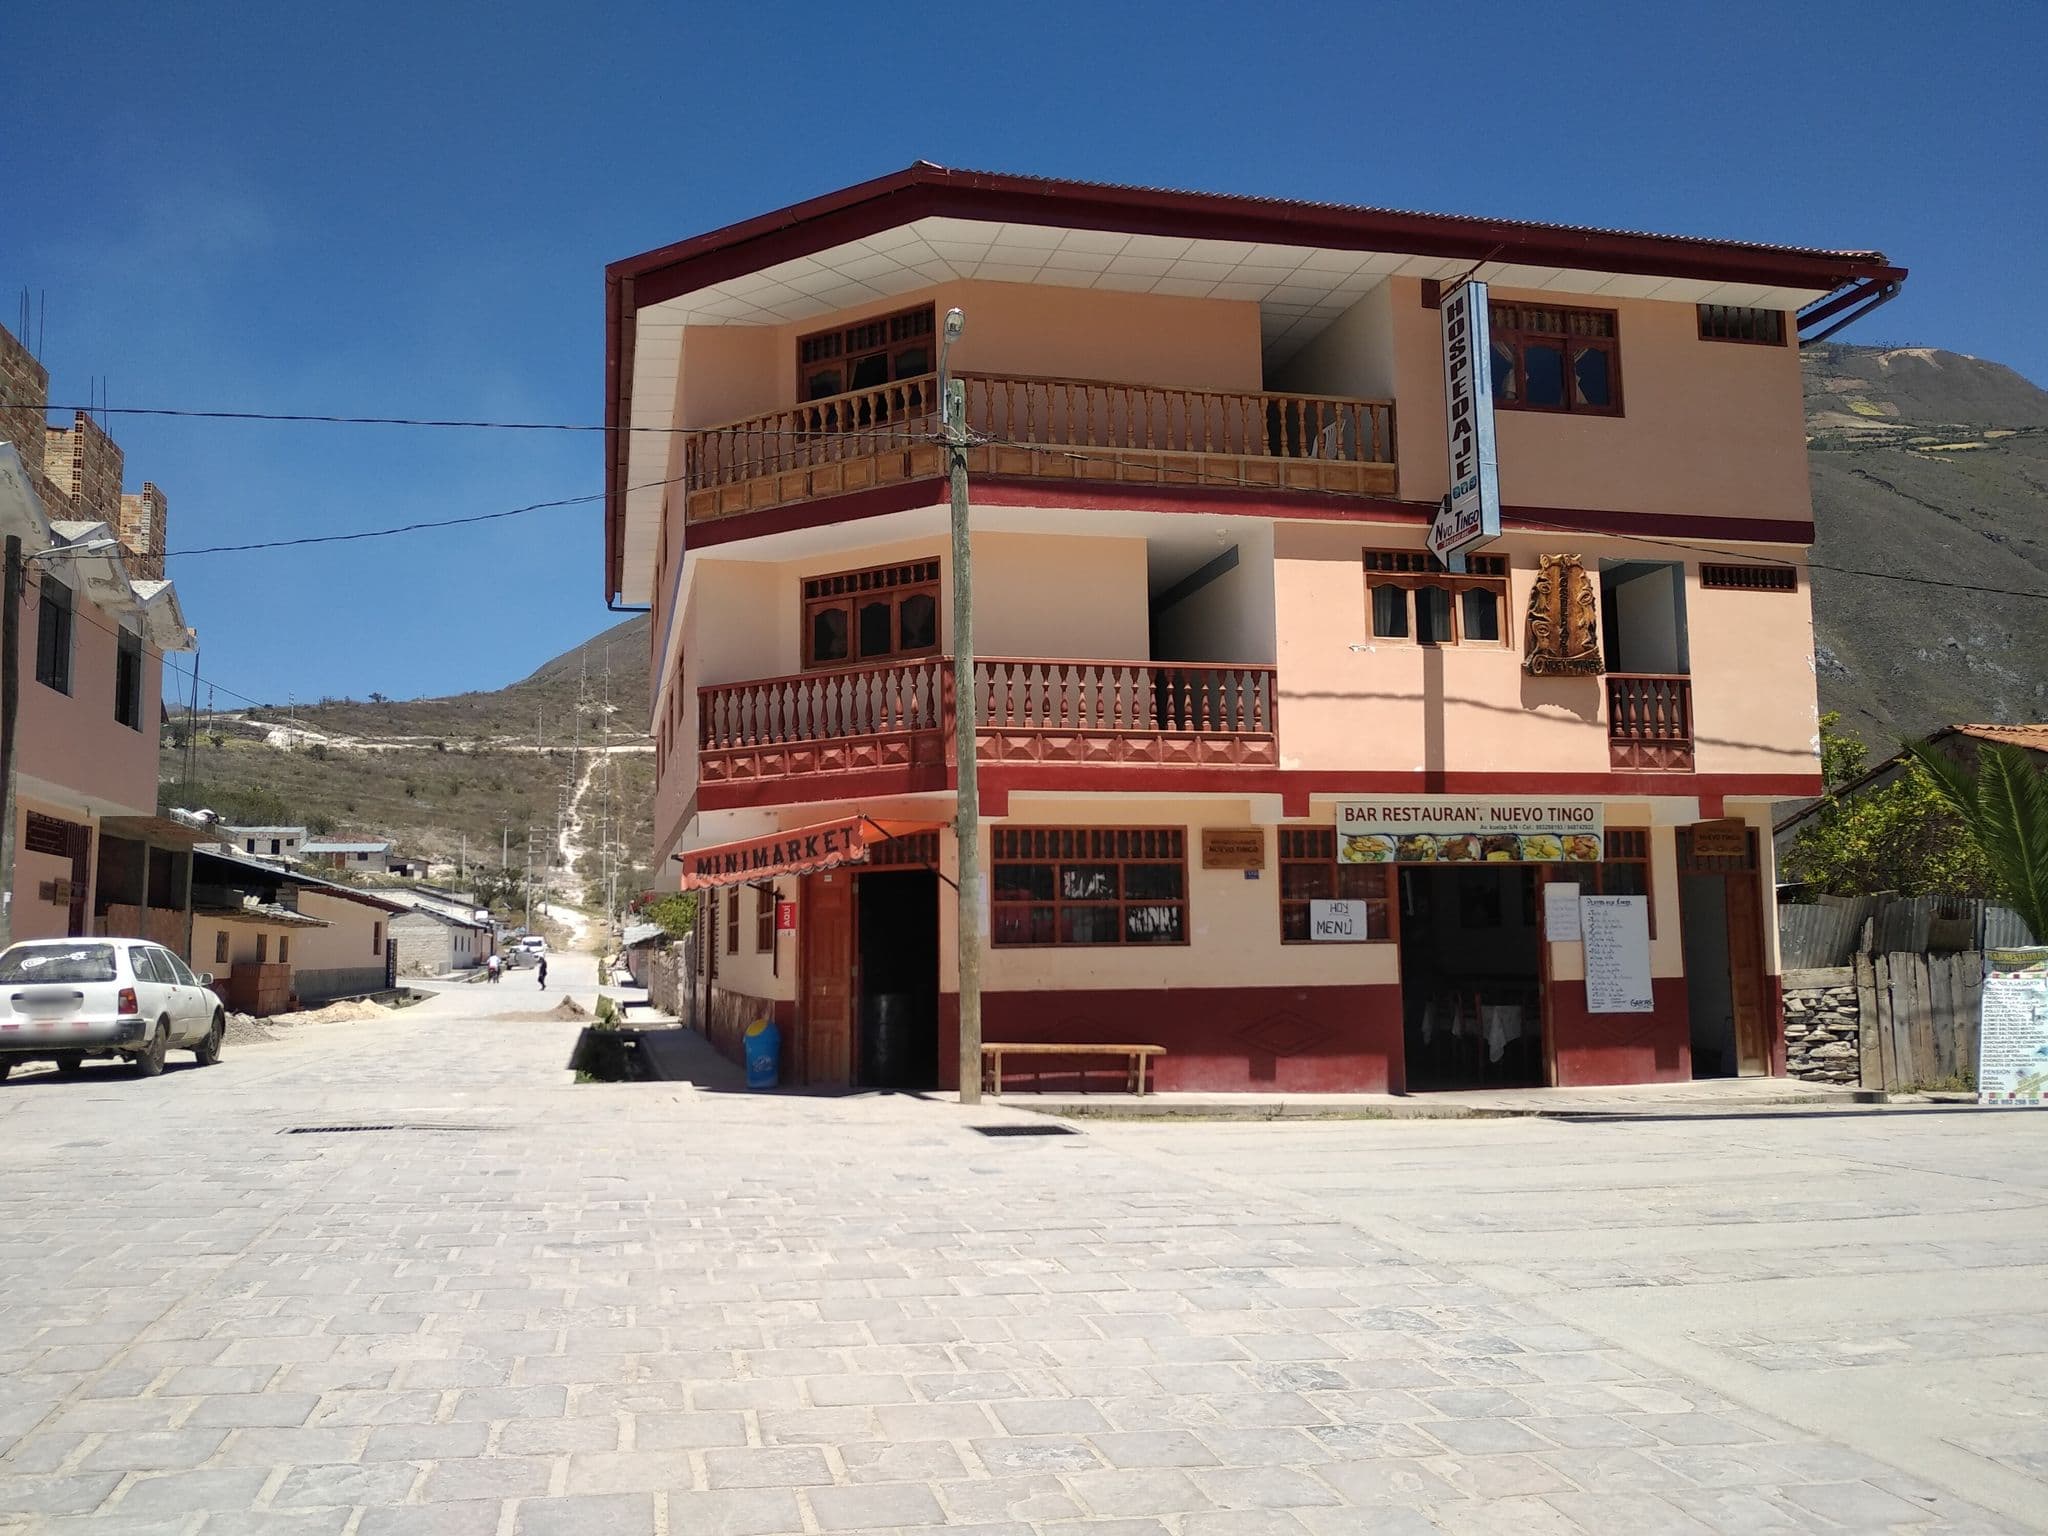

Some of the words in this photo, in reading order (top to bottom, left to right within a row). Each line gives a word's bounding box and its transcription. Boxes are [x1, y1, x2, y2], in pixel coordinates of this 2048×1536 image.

[1446, 297, 1472, 480] HOSPEDAJE
[1345, 807, 1377, 821] BAR
[1490, 807, 1543, 822] NUEVO
[1547, 807, 1594, 822] TINGO
[696, 826, 853, 876] MINIMARKET
[1329, 902, 1349, 913] HOY
